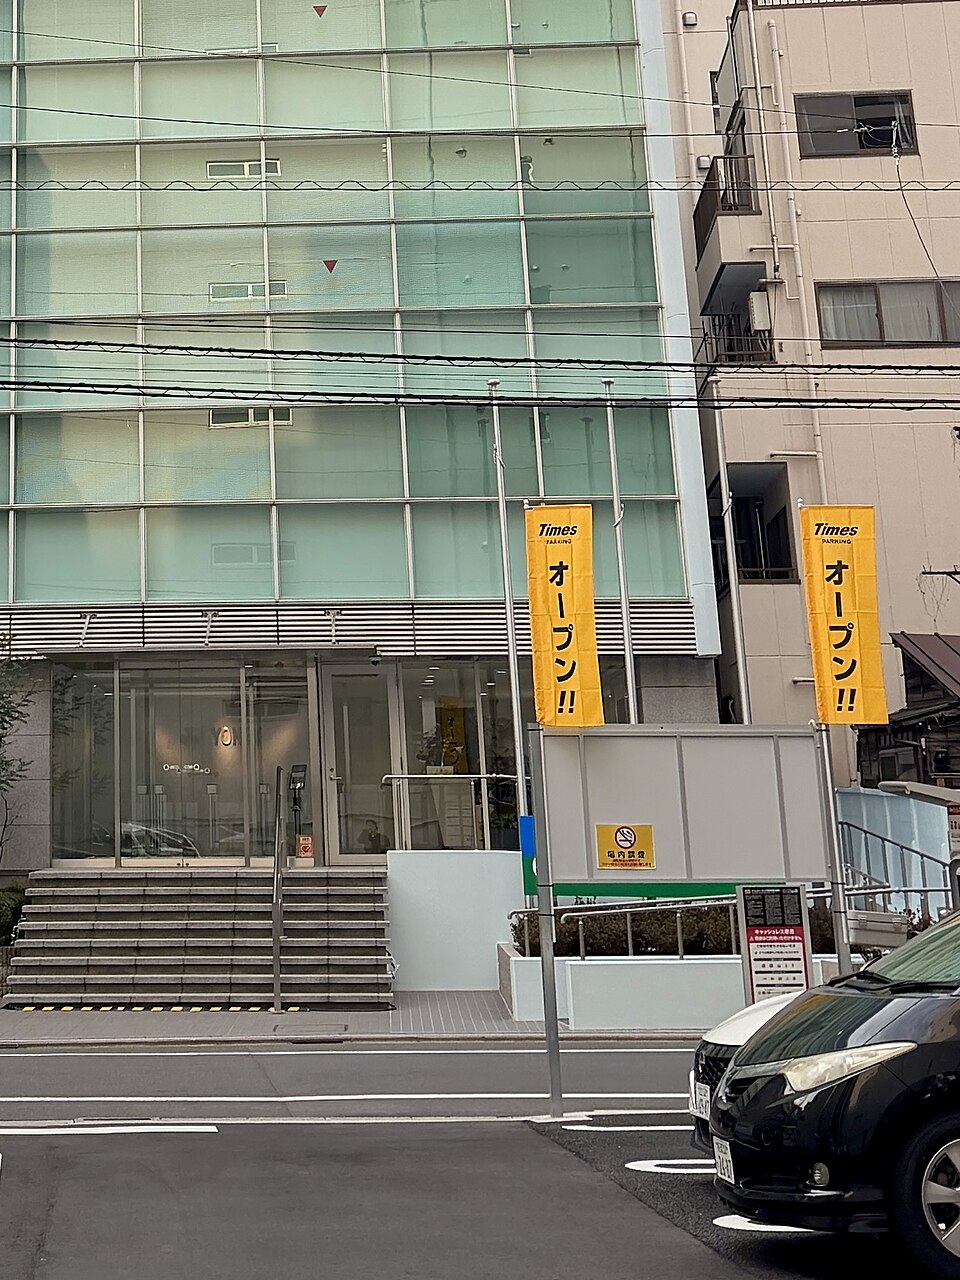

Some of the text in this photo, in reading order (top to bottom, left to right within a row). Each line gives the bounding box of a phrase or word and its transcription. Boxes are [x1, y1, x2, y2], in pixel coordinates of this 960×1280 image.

[538, 523, 578, 537] Times
[814, 522, 859, 536] Times
[548, 560, 577, 714] オープン!!
[824, 559, 858, 712] オープン!!
